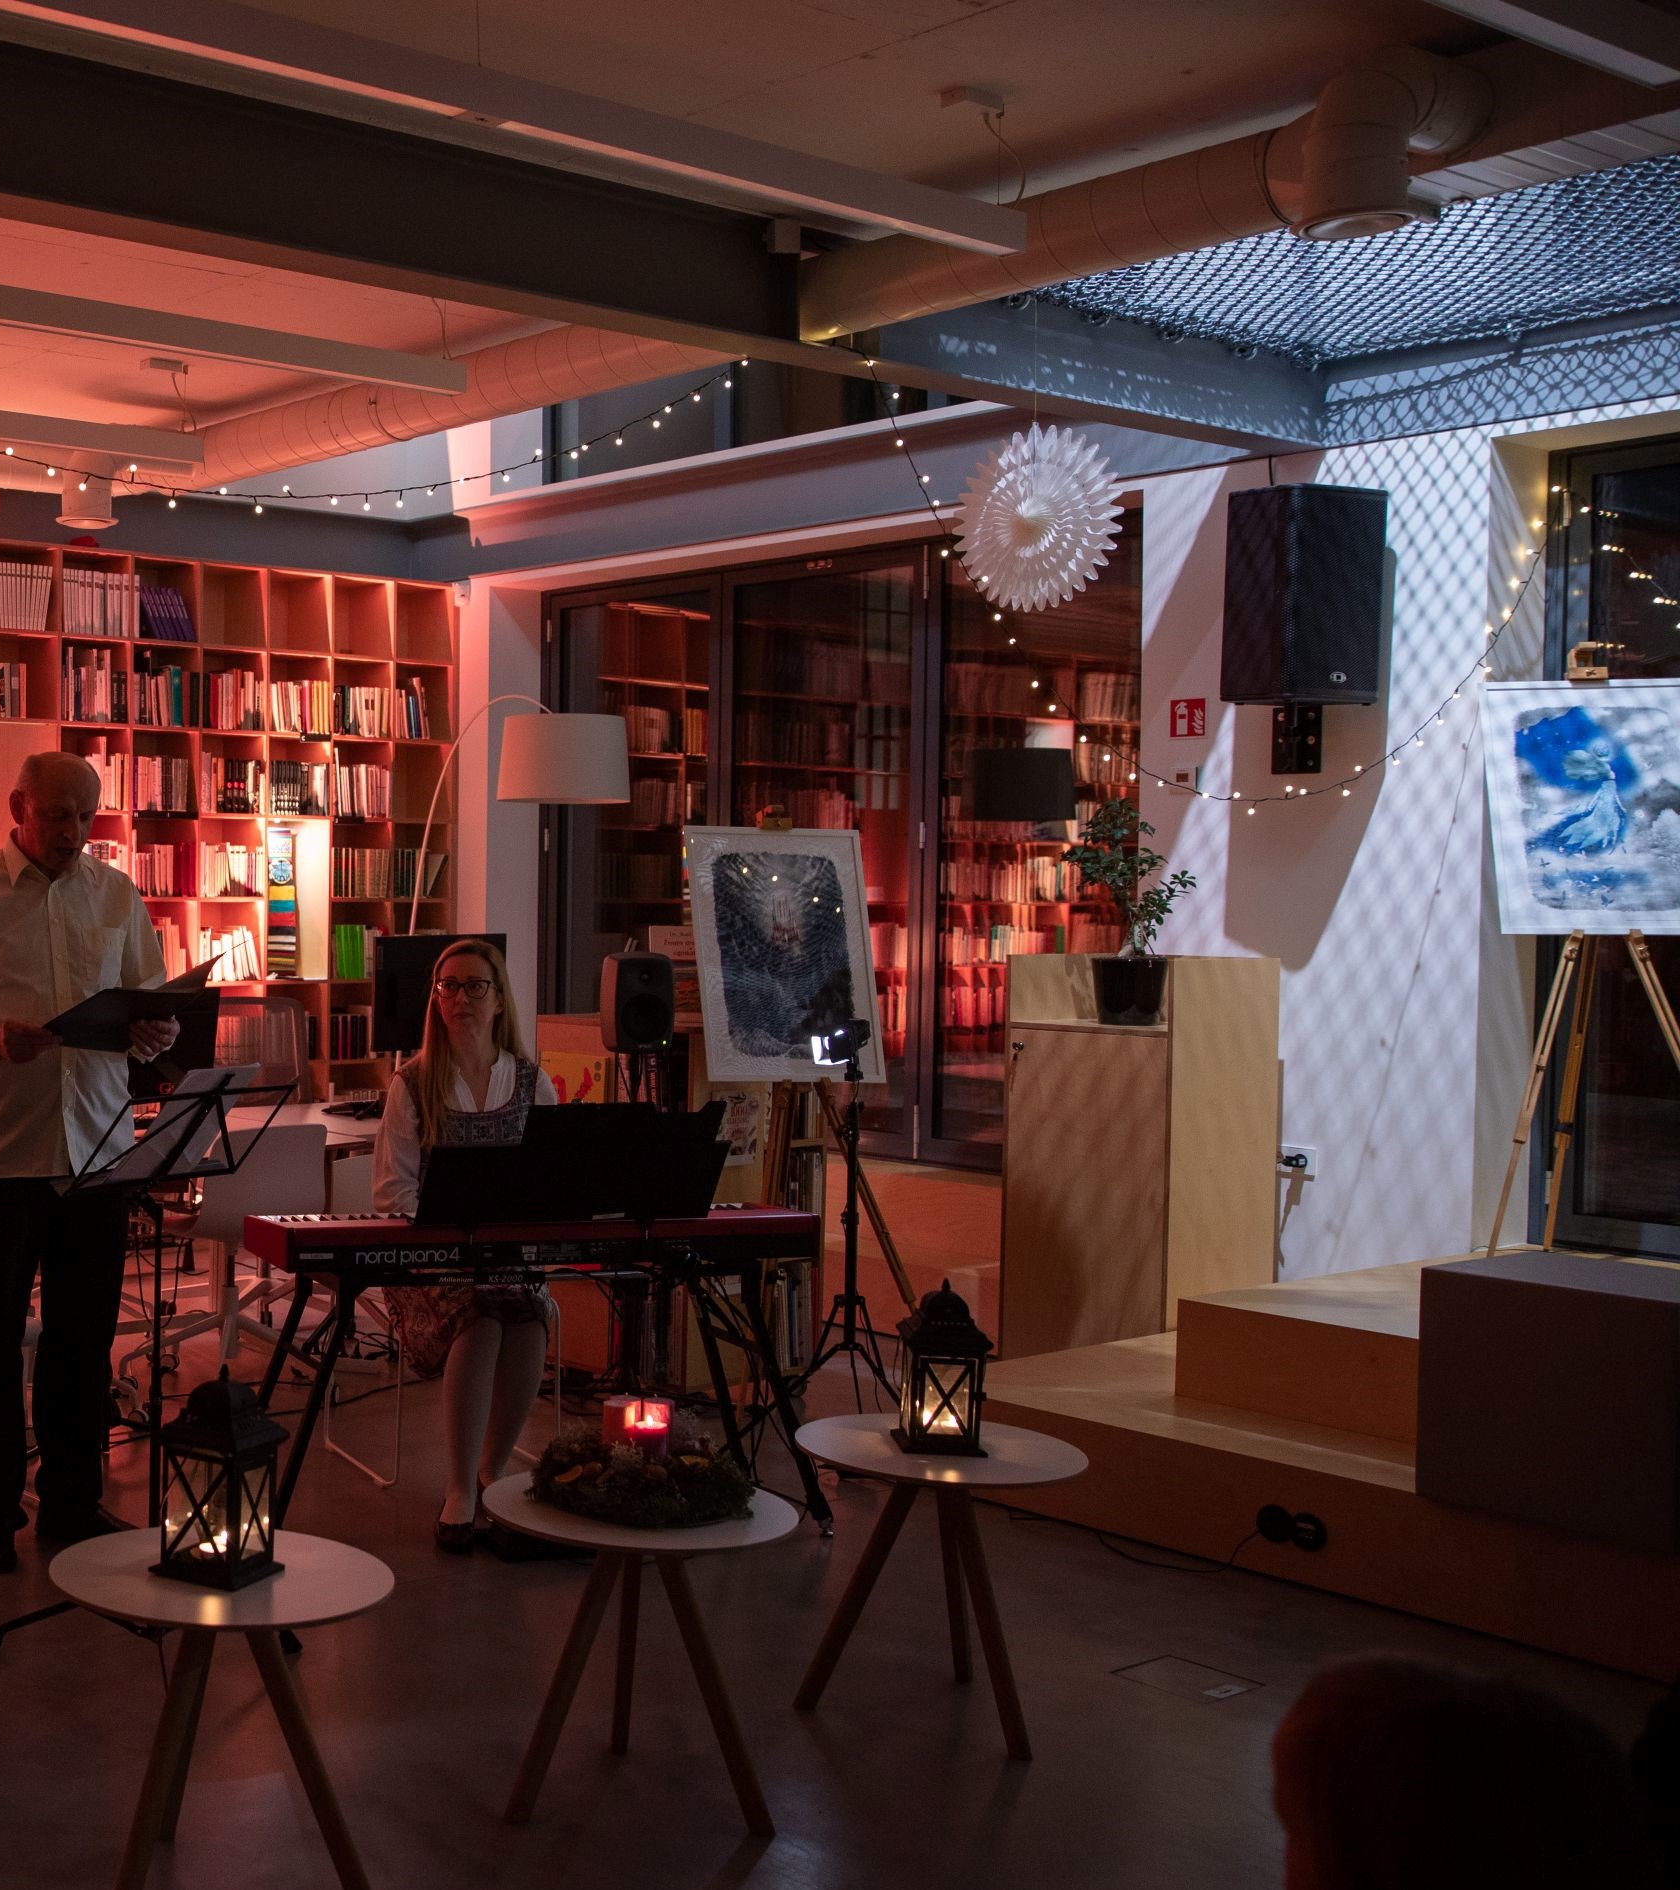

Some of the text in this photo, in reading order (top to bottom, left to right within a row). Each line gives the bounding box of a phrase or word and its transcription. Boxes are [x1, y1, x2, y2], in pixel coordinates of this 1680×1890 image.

[355, 1248, 396, 1265] nord
[400, 1249, 447, 1265] piano
[488, 1274, 523, 1283] KS-2000
